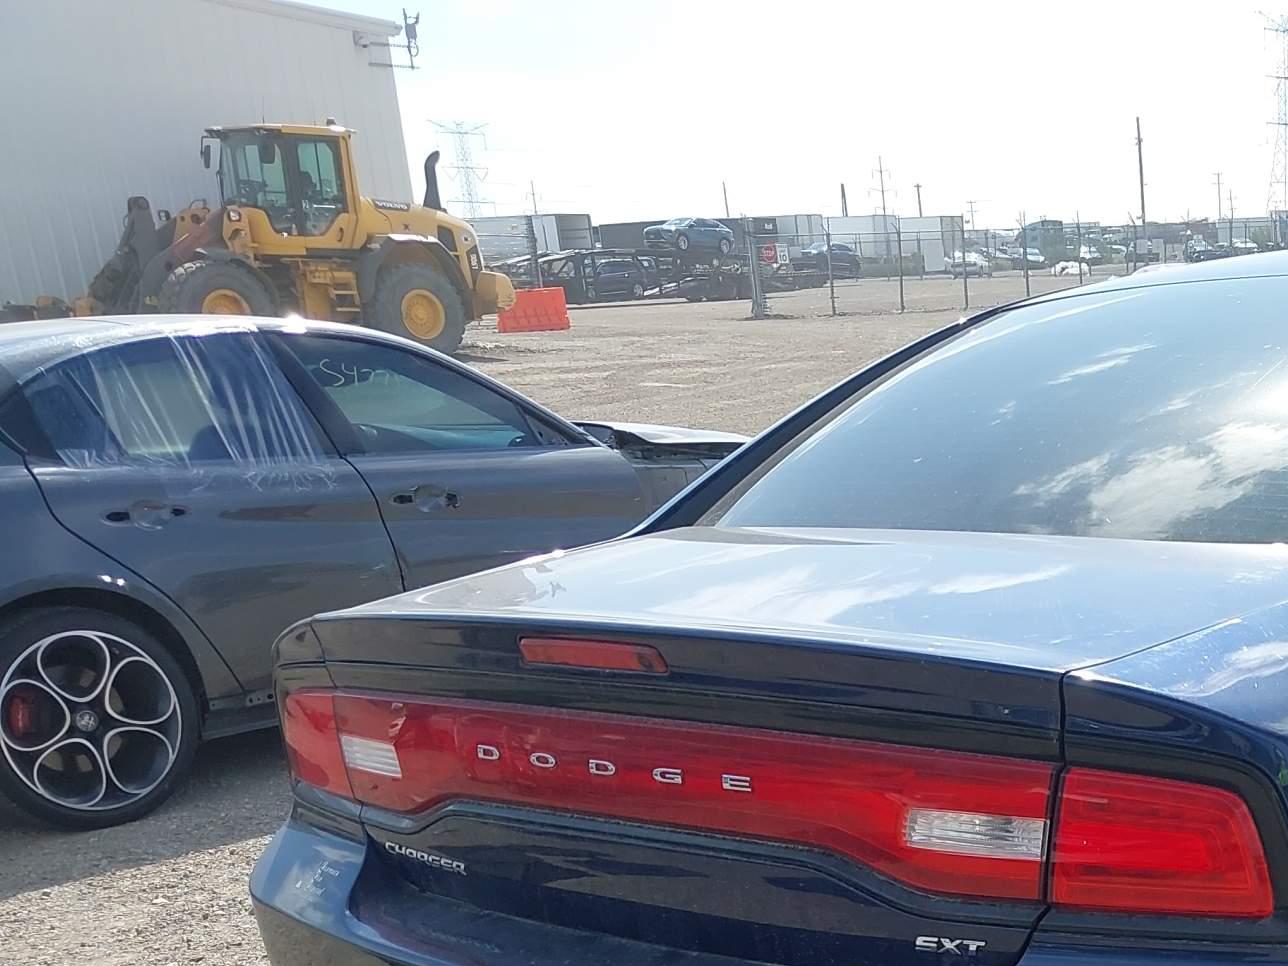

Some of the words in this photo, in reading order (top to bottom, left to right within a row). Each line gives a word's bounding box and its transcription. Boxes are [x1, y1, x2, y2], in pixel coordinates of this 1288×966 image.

[476, 743, 752, 792] DODGE
[385, 842, 468, 876] CHARGER
[914, 935, 987, 956] SXT
